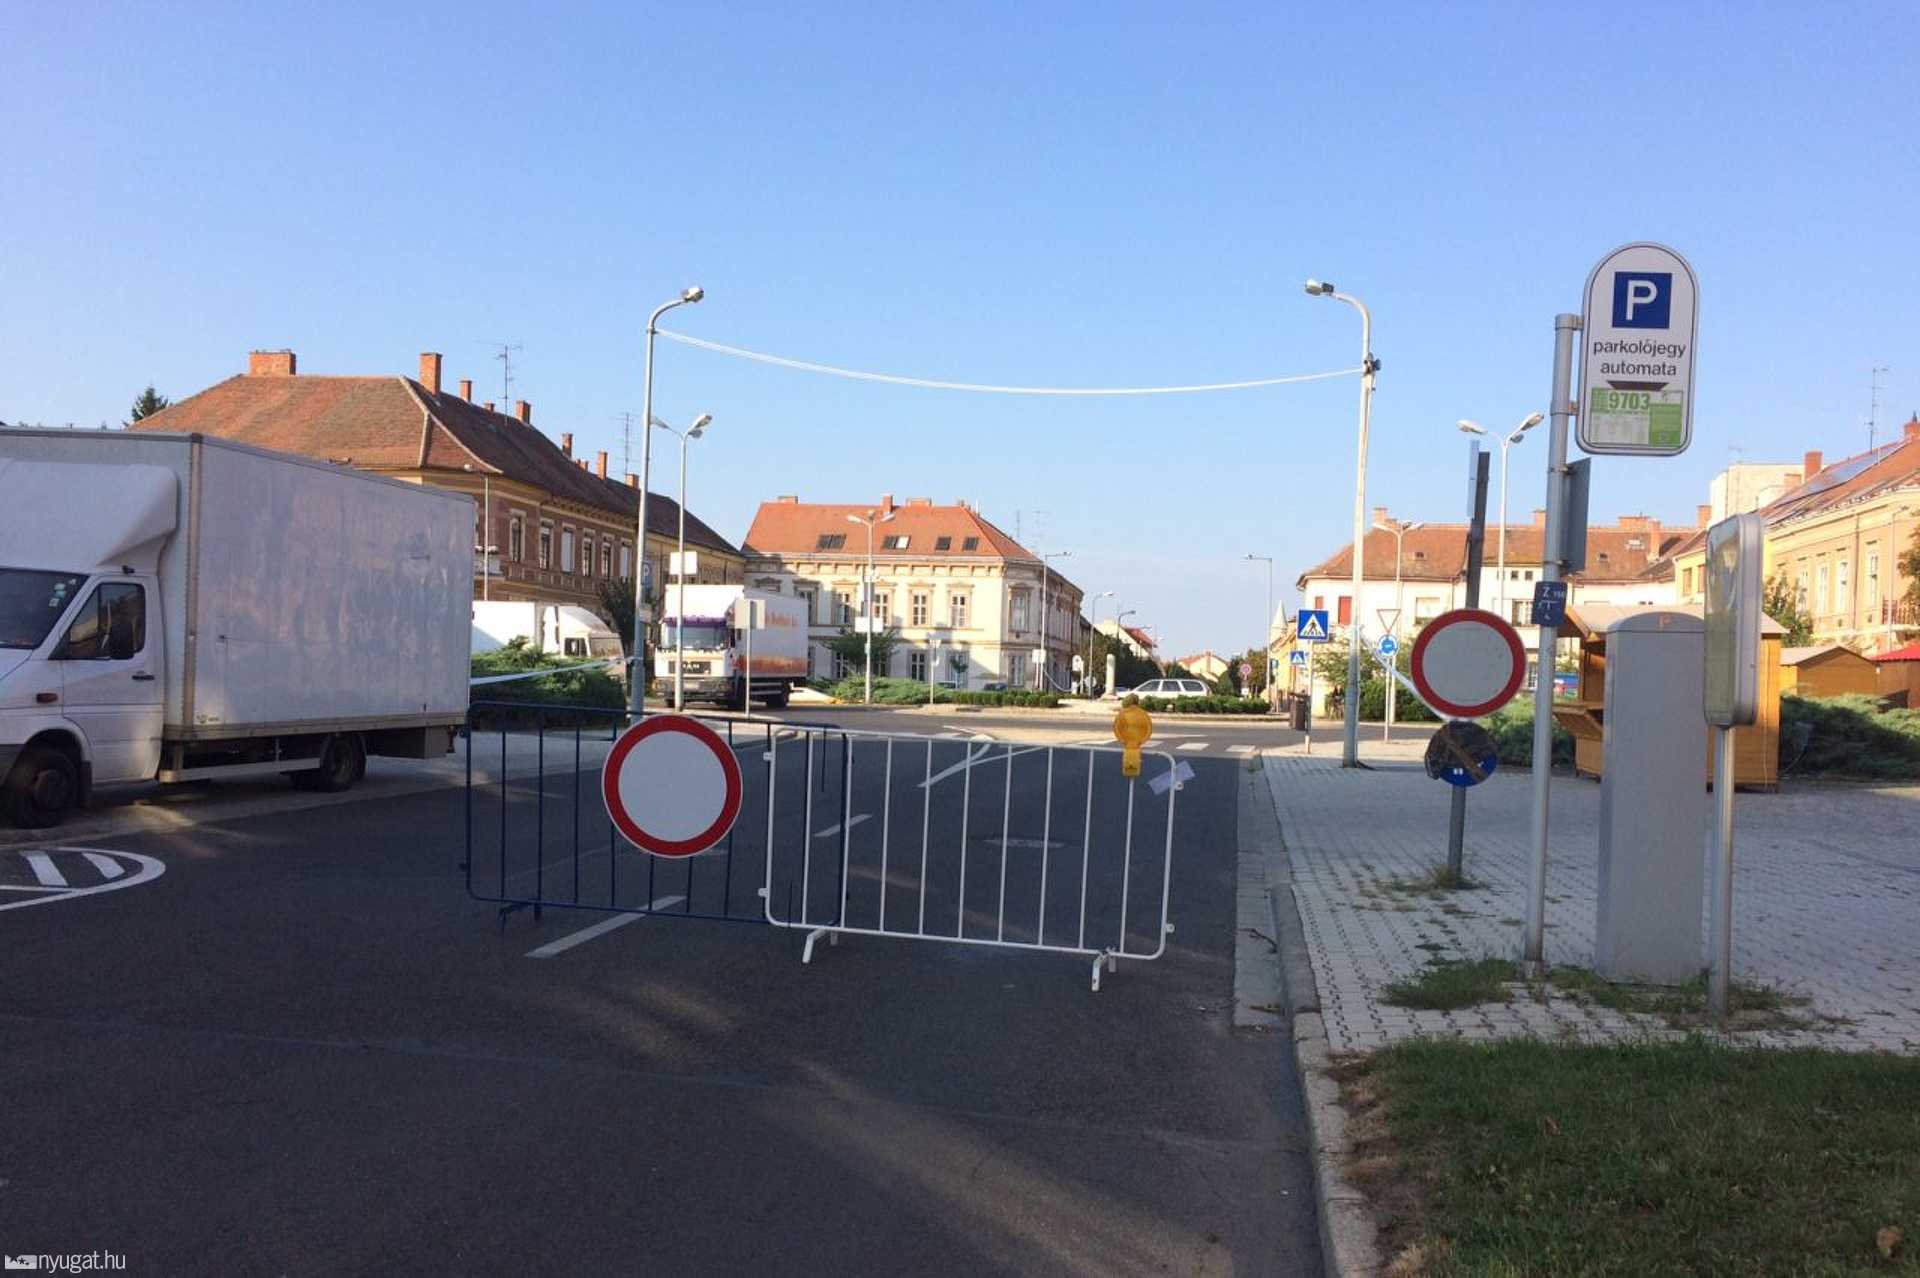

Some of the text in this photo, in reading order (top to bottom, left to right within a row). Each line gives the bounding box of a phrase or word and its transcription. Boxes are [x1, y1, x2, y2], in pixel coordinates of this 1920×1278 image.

[1626, 280, 1658, 320] P
[1593, 339, 1686, 358] parkolójegy
[1600, 360, 1677, 377] automata
[1608, 391, 1650, 409] 9703
